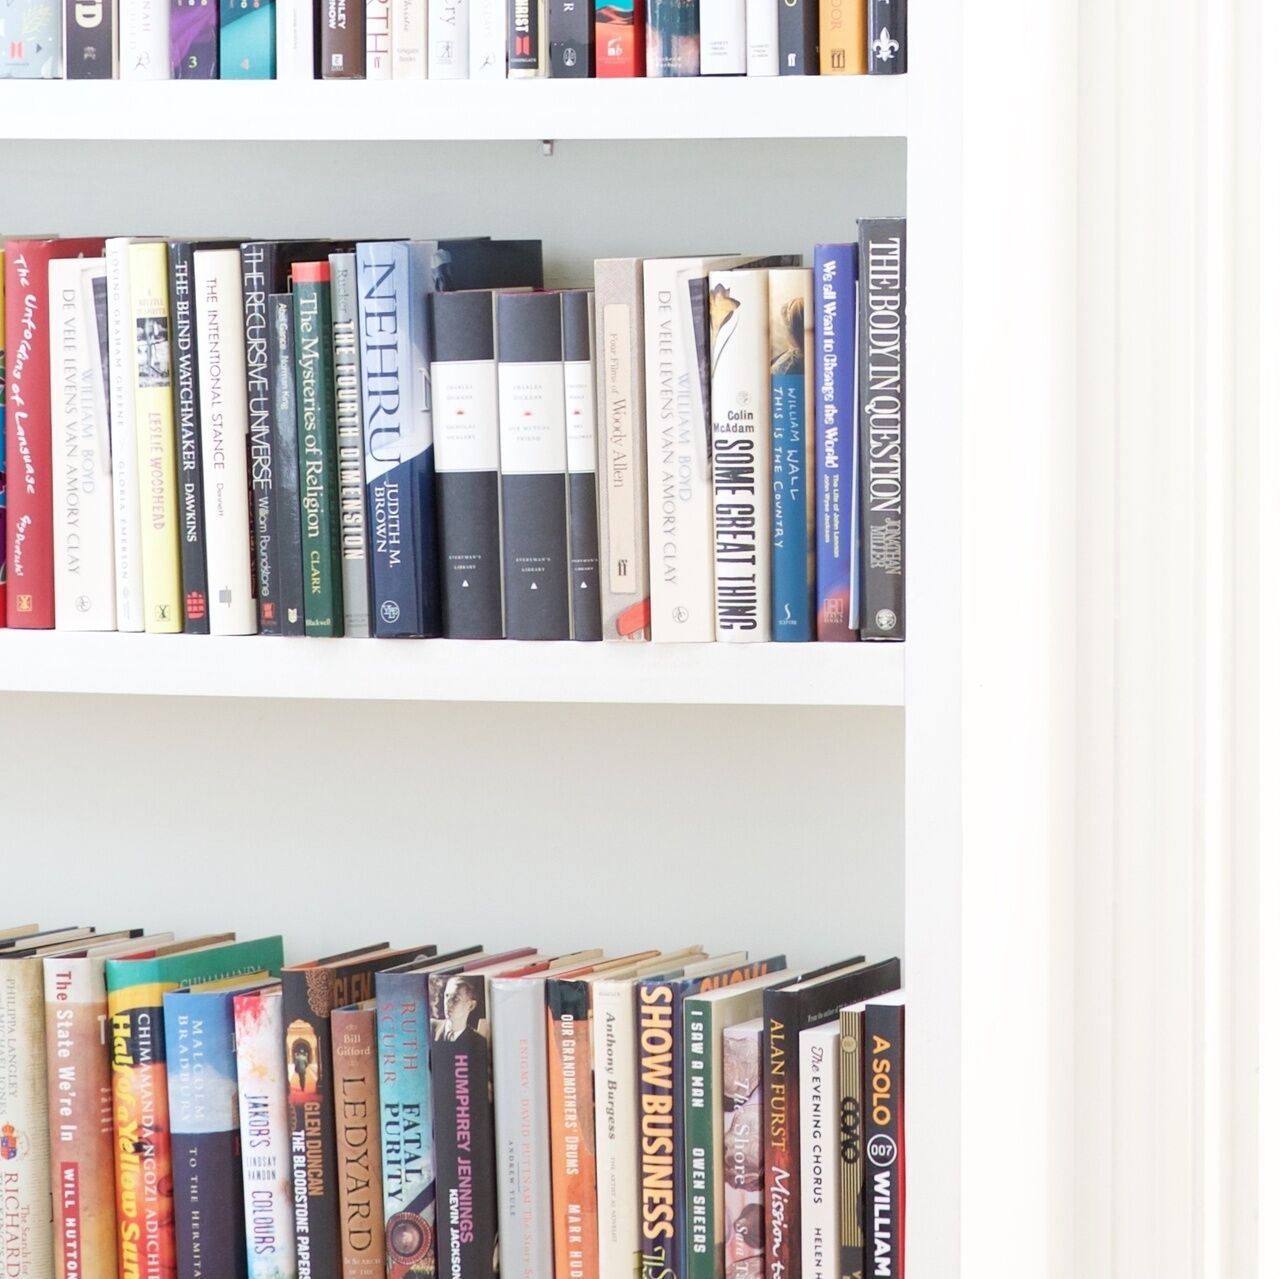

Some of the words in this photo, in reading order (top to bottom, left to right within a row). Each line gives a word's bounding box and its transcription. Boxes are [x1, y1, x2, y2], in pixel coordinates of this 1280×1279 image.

[12, 256, 31, 287] The
[175, 262, 189, 295] THE
[868, 238, 900, 289] THE
[11, 294, 38, 378] Unfolding
[177, 301, 191, 350] BLIND
[300, 293, 317, 333] The
[334, 320, 355, 355] THE
[868, 293, 900, 358] BODY
[299, 337, 320, 430] Mysteries
[363, 261, 402, 464] NEHRU
[868, 363, 900, 392] IN
[11, 383, 24, 406] of
[177, 354, 195, 470] WATCHMAKER
[336, 364, 360, 437] FOURTH
[14, 412, 37, 494] Language
[306, 435, 320, 454] of
[715, 440, 755, 495] SOME
[865, 396, 901, 513] QUESTION
[185, 483, 197, 542] DAWKINS
[302, 459, 323, 538] Religion
[339, 448, 364, 560] DIMENSION
[375, 486, 388, 553] BROWN
[383, 481, 399, 544] JUDITH
[389, 548, 401, 568] M.
[716, 504, 756, 566] GREAT
[310, 551, 321, 594] CLARK
[717, 574, 757, 630] THING
[56, 971, 73, 1000] The
[57, 1010, 74, 1057] State
[640, 986, 673, 1088] SHOW
[769, 1019, 785, 1076] ALAN
[872, 1036, 890, 1054] A
[59, 1066, 75, 1116] We're
[138, 1014, 153, 1137] CHIMAMANDA
[455, 1055, 470, 1151] HUMPHREY
[872, 1059, 891, 1125] SOLO
[61, 1125, 76, 1141] In
[402, 1104, 422, 1183] FATAL
[771, 1084, 786, 1151] FURST
[142, 1145, 156, 1201] NGOZI
[342, 1076, 372, 1251] LEDYARD
[384, 1103, 403, 1203] PURITY
[641, 1095, 674, 1238] BUSINESS
[692, 1148, 705, 1189] OWEN
[458, 1157, 473, 1243] JENNINGS
[693, 1196, 706, 1253] SHEERS
[874, 1171, 890, 1275] WILLIAM
